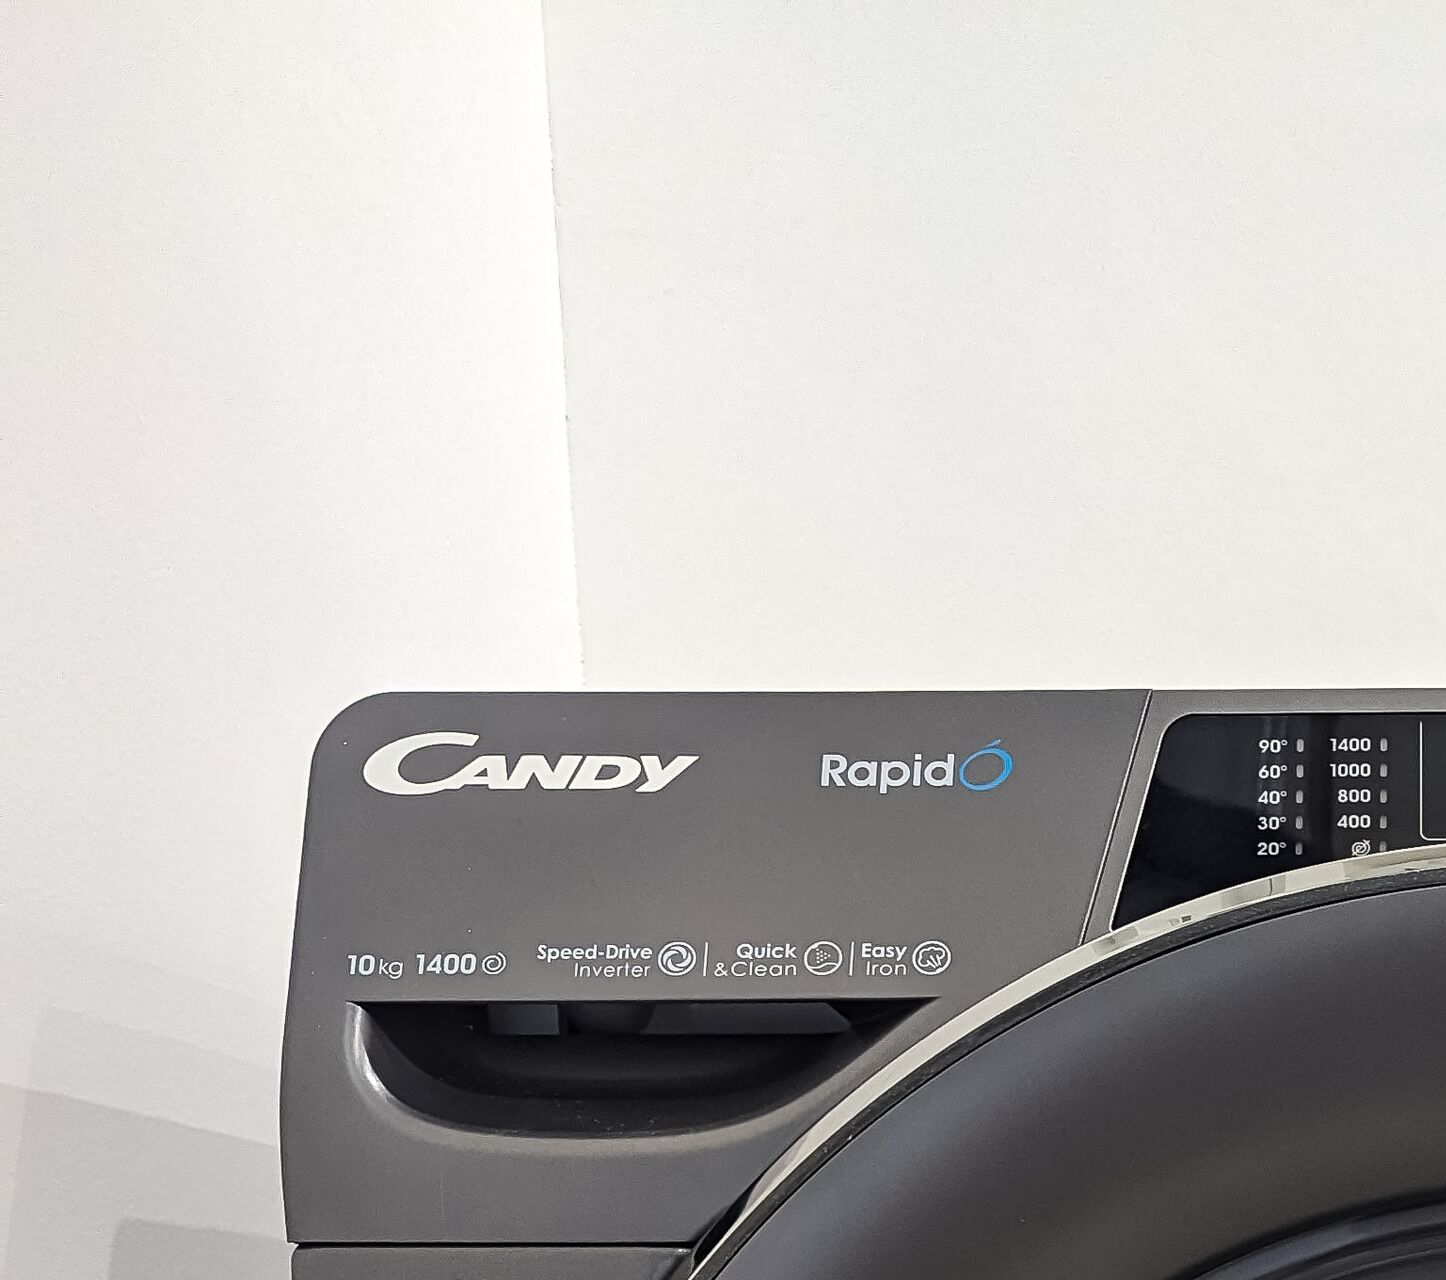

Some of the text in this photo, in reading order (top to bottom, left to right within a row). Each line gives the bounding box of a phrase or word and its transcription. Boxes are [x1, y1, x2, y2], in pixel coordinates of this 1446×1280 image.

[1258, 739, 1288, 753] 90°
[1329, 737, 1371, 752] 1400
[362, 731, 699, 795] CANDY
[1329, 763, 1371, 778] 1000
[1258, 764, 1288, 779] 60°
[1257, 790, 1288, 805] 40°
[1337, 789, 1371, 803] 800
[1257, 816, 1287, 830] 30°
[1336, 814, 1371, 829] 400
[1256, 841, 1287, 856] 20°
[536, 944, 653, 963] Speed-Drive
[736, 943, 797, 960] Quick
[861, 943, 907, 963] Easy
[347, 953, 477, 979] 10 kg 1400
[573, 962, 651, 978] Inverter
[865, 960, 907, 976] Iron
